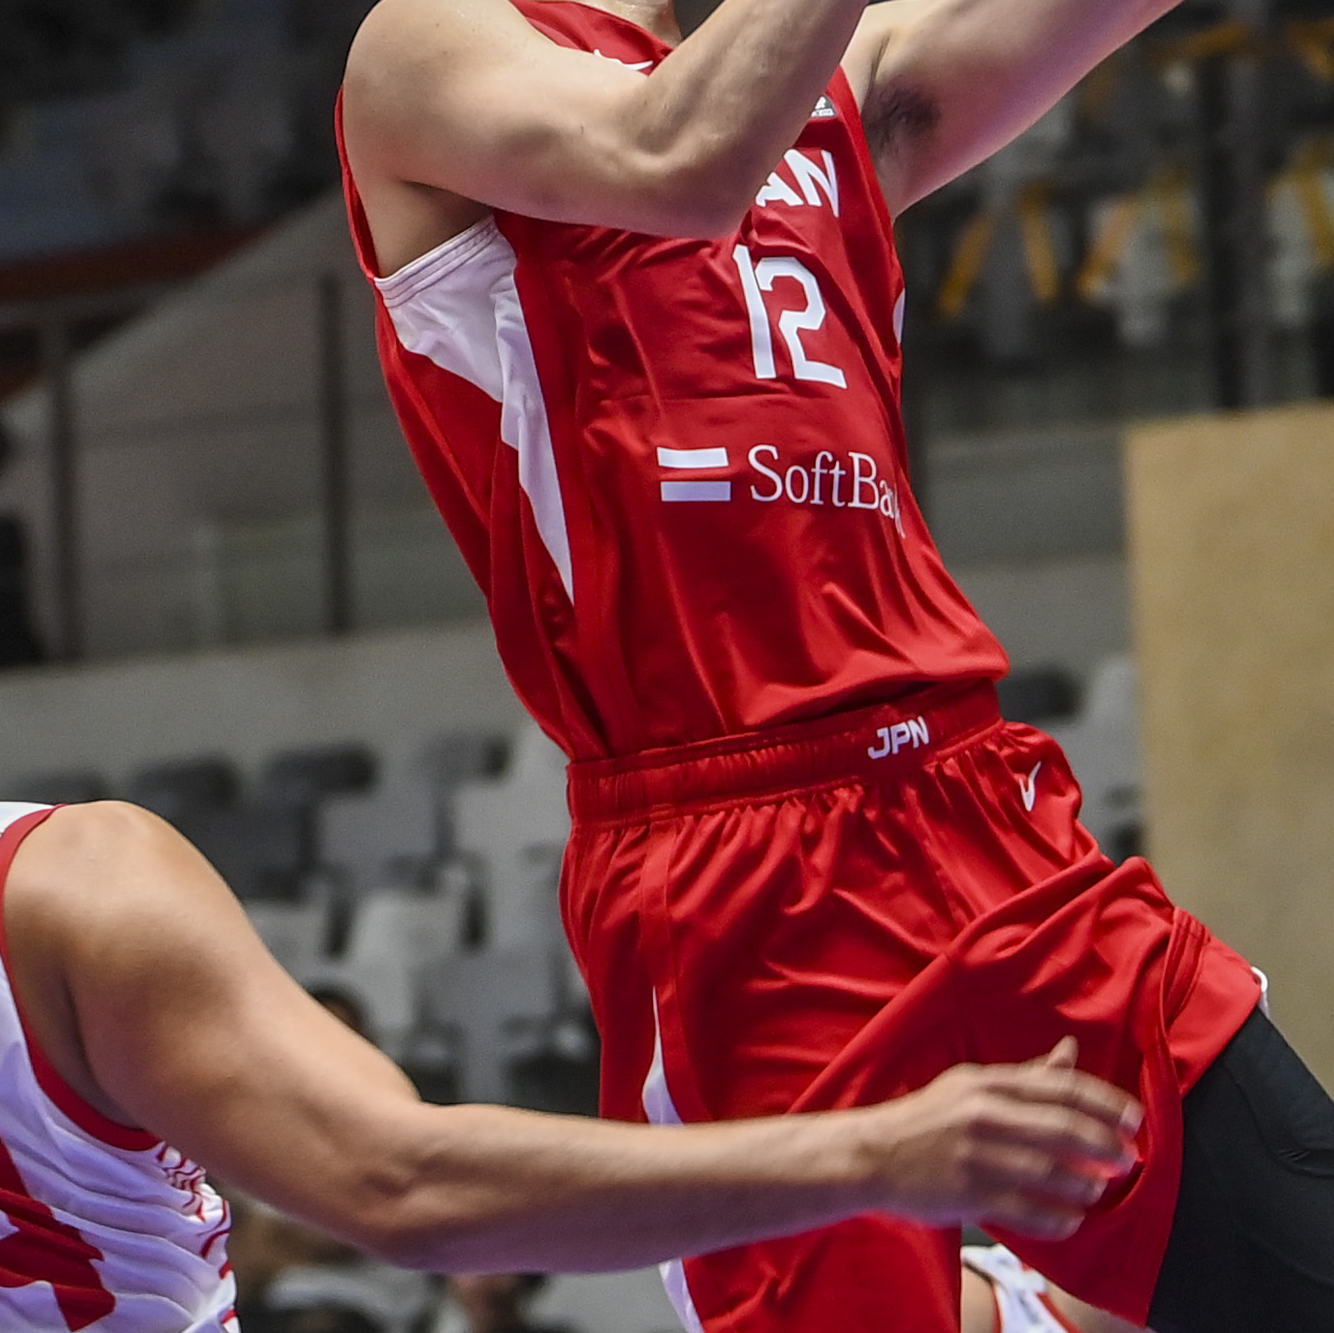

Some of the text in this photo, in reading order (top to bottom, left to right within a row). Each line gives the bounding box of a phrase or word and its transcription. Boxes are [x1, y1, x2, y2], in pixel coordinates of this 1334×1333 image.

[732, 243, 848, 389] 12
[748, 444, 906, 539] SoftBa
[867, 715, 930, 760] JPN
